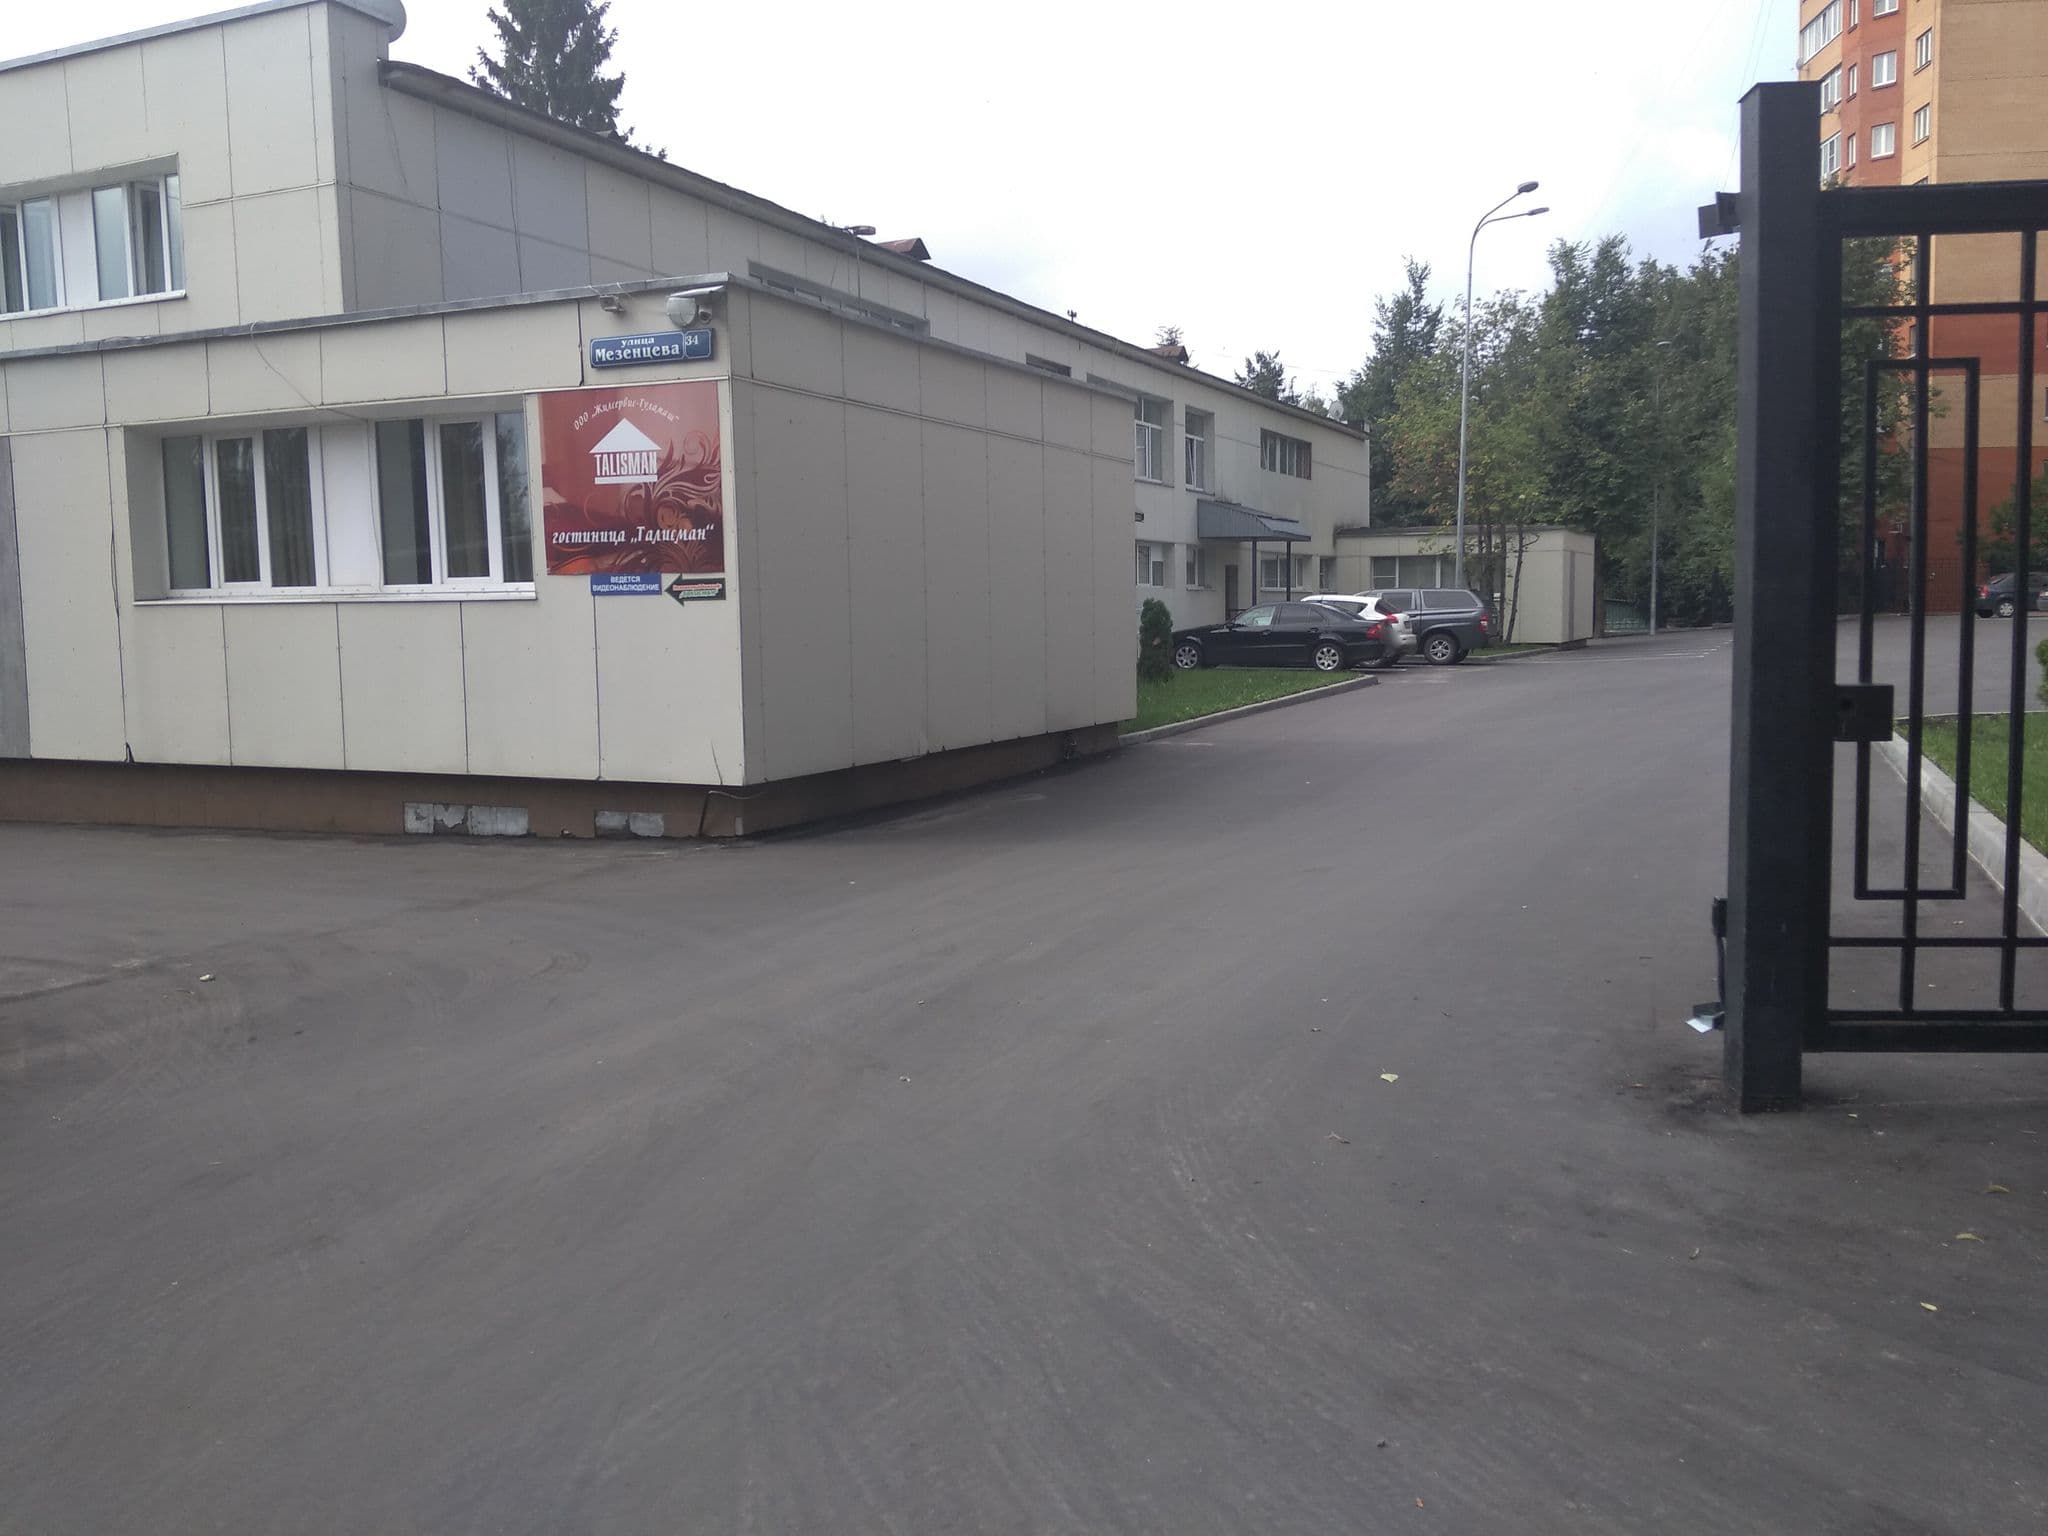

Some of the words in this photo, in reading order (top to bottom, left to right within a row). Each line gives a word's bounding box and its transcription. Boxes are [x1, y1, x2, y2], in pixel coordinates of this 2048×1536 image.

[620, 337, 655, 348] улица
[685, 334, 699, 346] 34
[595, 343, 680, 362] Мезенцева
[574, 411, 590, 431] ООО
[594, 451, 657, 476] TALISMAN
[552, 529, 626, 546] гостиница
[592, 583, 660, 592] ВИДЕОНАБЛЮДЕНИЕ
